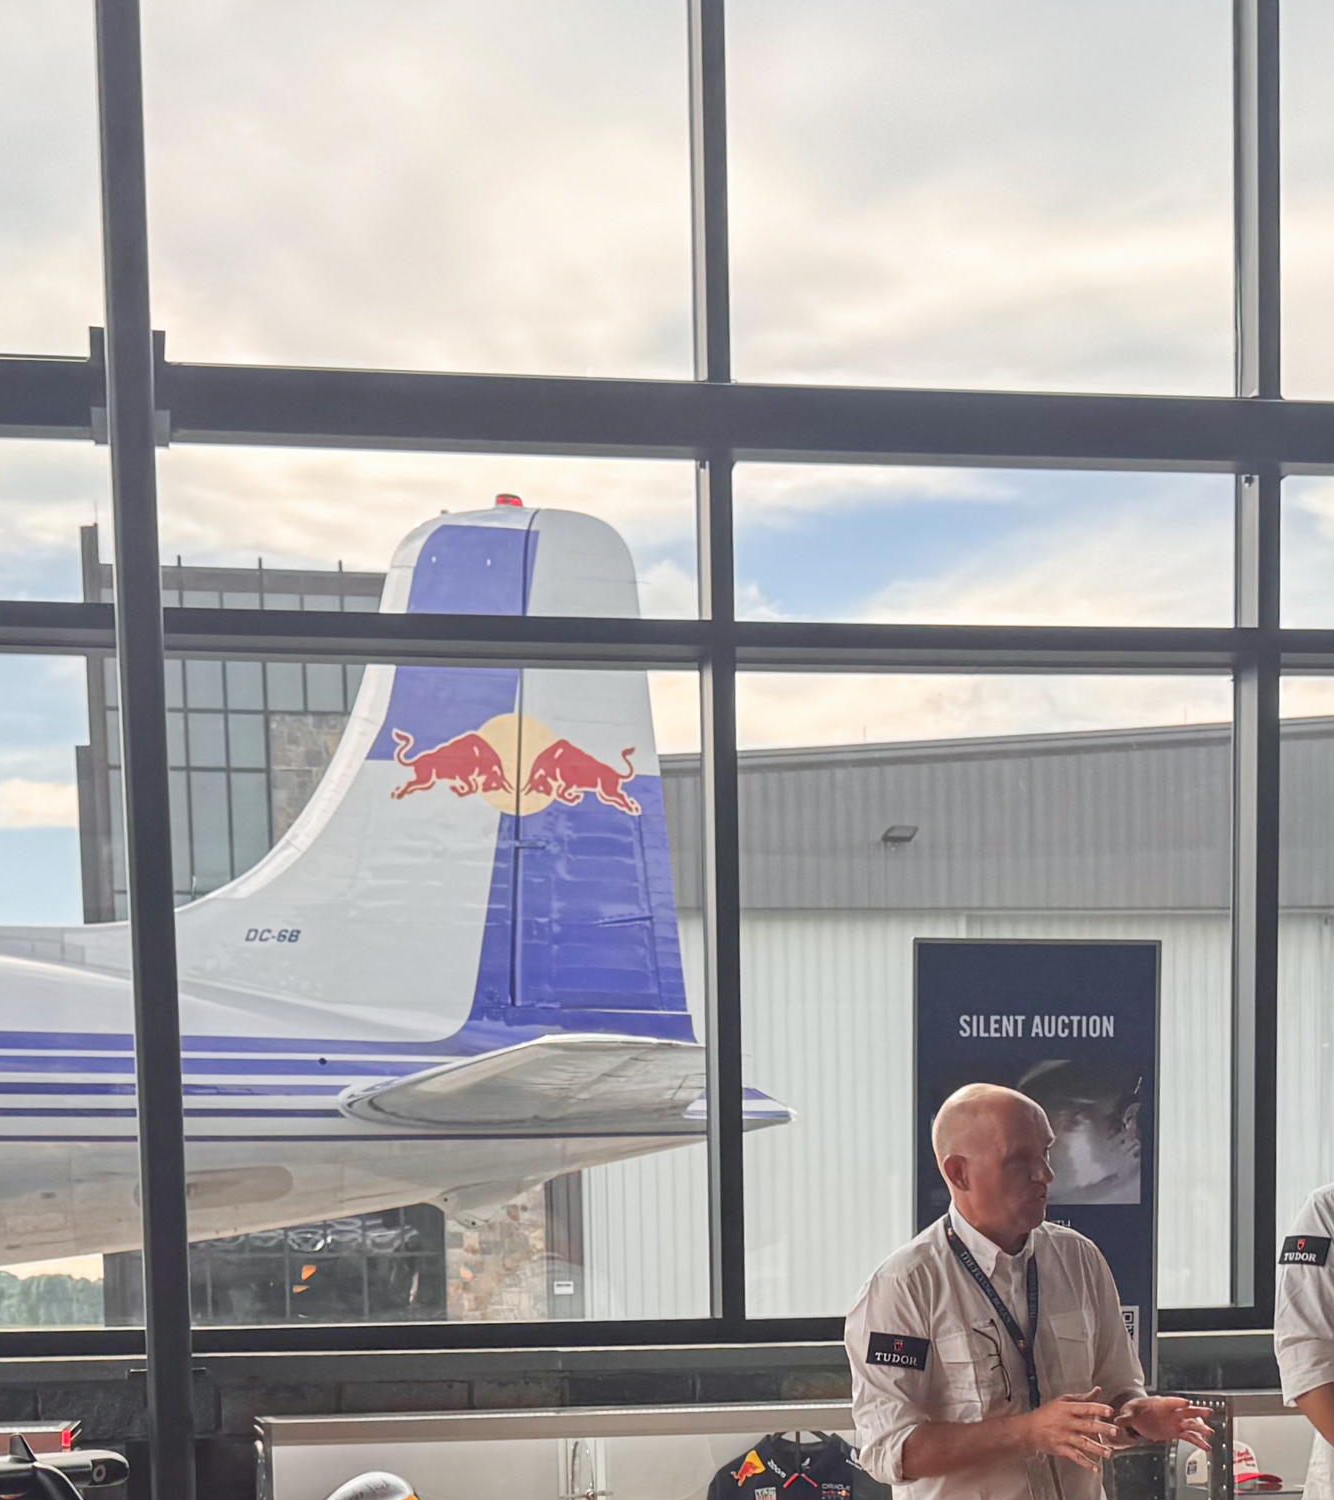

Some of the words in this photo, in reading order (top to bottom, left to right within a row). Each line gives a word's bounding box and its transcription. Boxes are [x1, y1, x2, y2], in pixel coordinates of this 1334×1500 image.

[244, 928, 301, 943] DC-6B
[959, 1015, 1026, 1038] SILENT
[1031, 1015, 1115, 1038] AUCTION
[1284, 1251, 1317, 1263] TUDOR
[874, 1351, 918, 1366] TUDOR
